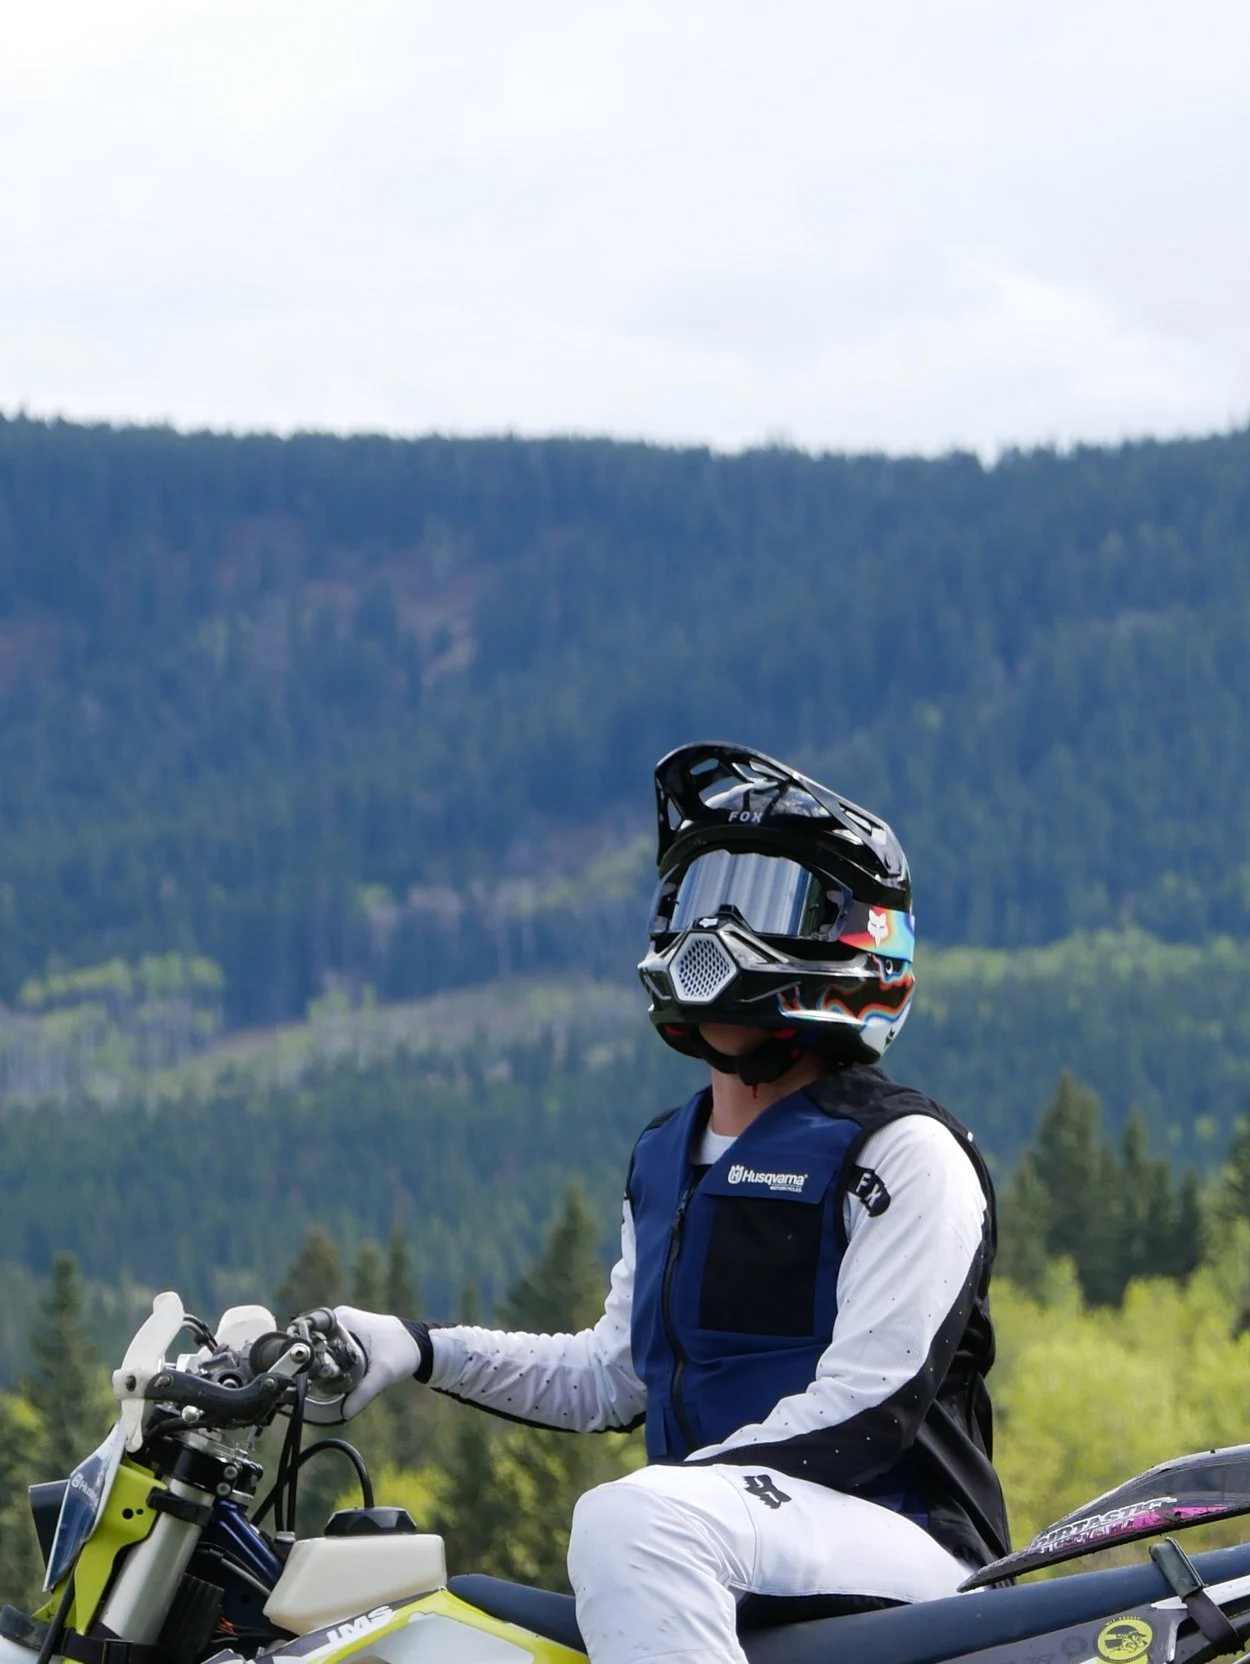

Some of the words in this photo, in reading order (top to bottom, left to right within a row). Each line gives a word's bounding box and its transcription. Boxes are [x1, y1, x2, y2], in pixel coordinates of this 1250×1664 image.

[728, 811, 762, 823] FOX
[743, 1169, 805, 1185] Husqvarna
[326, 1605, 393, 1645] IMS
